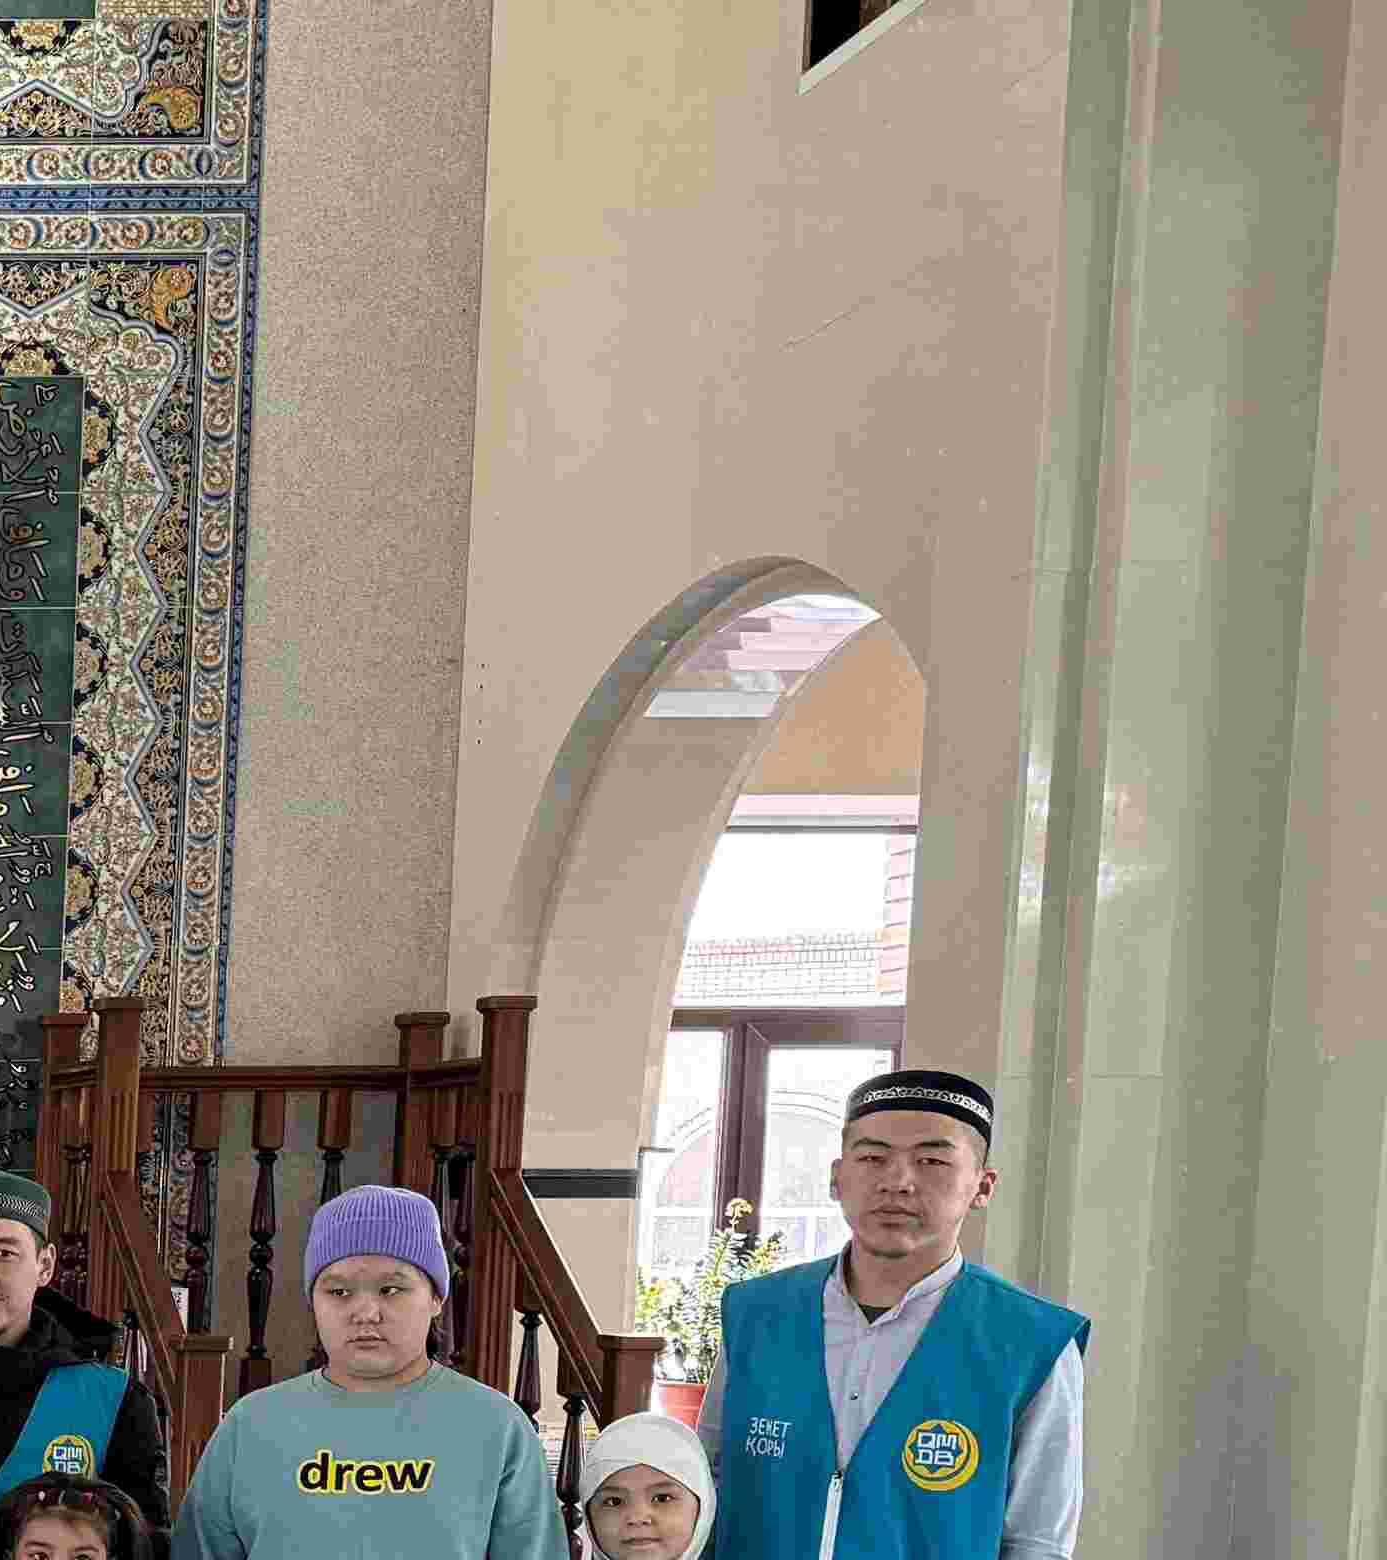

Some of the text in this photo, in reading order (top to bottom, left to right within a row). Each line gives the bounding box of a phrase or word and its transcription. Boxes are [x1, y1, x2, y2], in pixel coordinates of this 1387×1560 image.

[749, 1416, 793, 1440] ЗЕКЕТ
[745, 1436, 785, 1459] ҚОРЫ
[298, 1449, 435, 1494] drew
